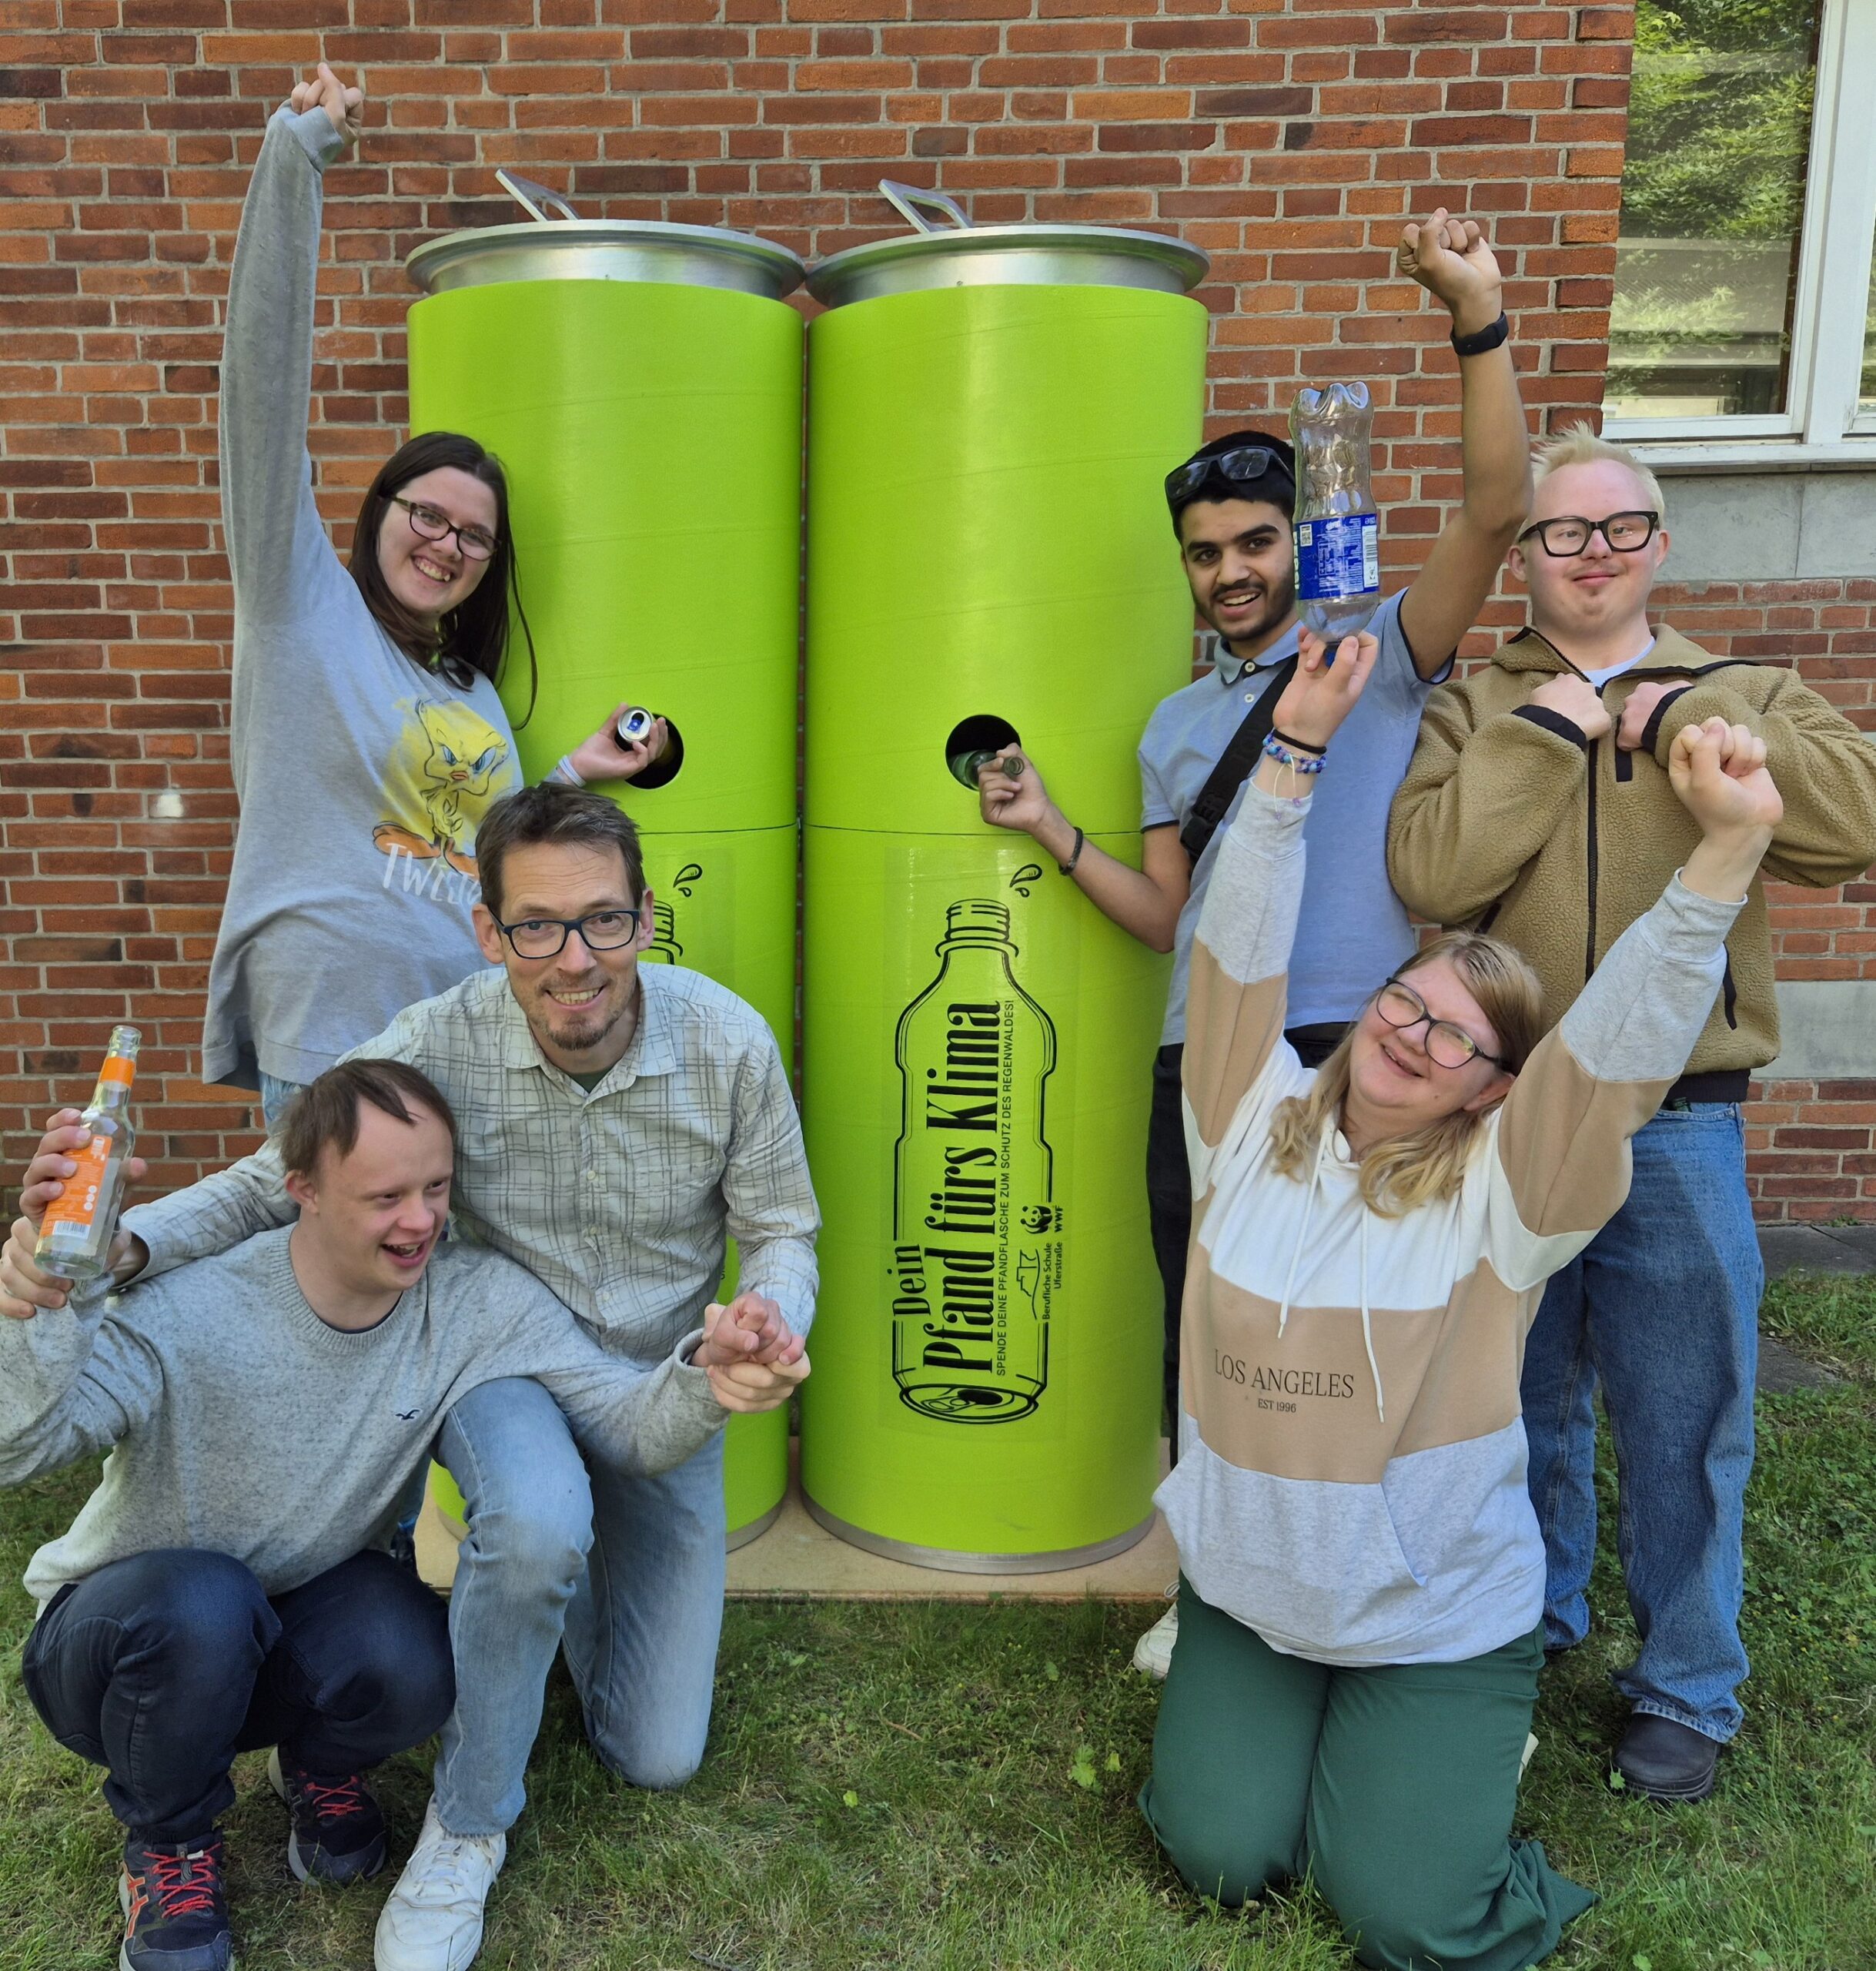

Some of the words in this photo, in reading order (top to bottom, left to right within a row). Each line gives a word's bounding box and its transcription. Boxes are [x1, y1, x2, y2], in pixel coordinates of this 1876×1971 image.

[926, 1000, 1001, 1133] Klima
[1003, 1000, 1014, 1092] REGENWALDES!
[1002, 1096, 1012, 1119] DES
[1001, 1123, 1011, 1169] SCHUTZ
[924, 1146, 998, 1235] fürs
[1001, 1172, 1010, 1198] ZUM
[1055, 1205, 1063, 1233] WWF
[998, 1201, 1009, 1290] PFANDFLASCHE
[1054, 1241, 1063, 1290] Uferstraße
[887, 1244, 931, 1316] Dein
[1042, 1271, 1052, 1320] Berufliche
[923, 1247, 995, 1374] Pfand
[998, 1294, 1007, 1327] DEINE
[997, 1332, 1006, 1376] SPENDE
[1215, 1349, 1246, 1384] LOS
[1251, 1366, 1354, 1398] ANGELES
[1258, 1398, 1274, 1410] EST
[1276, 1401, 1296, 1413] 1996
